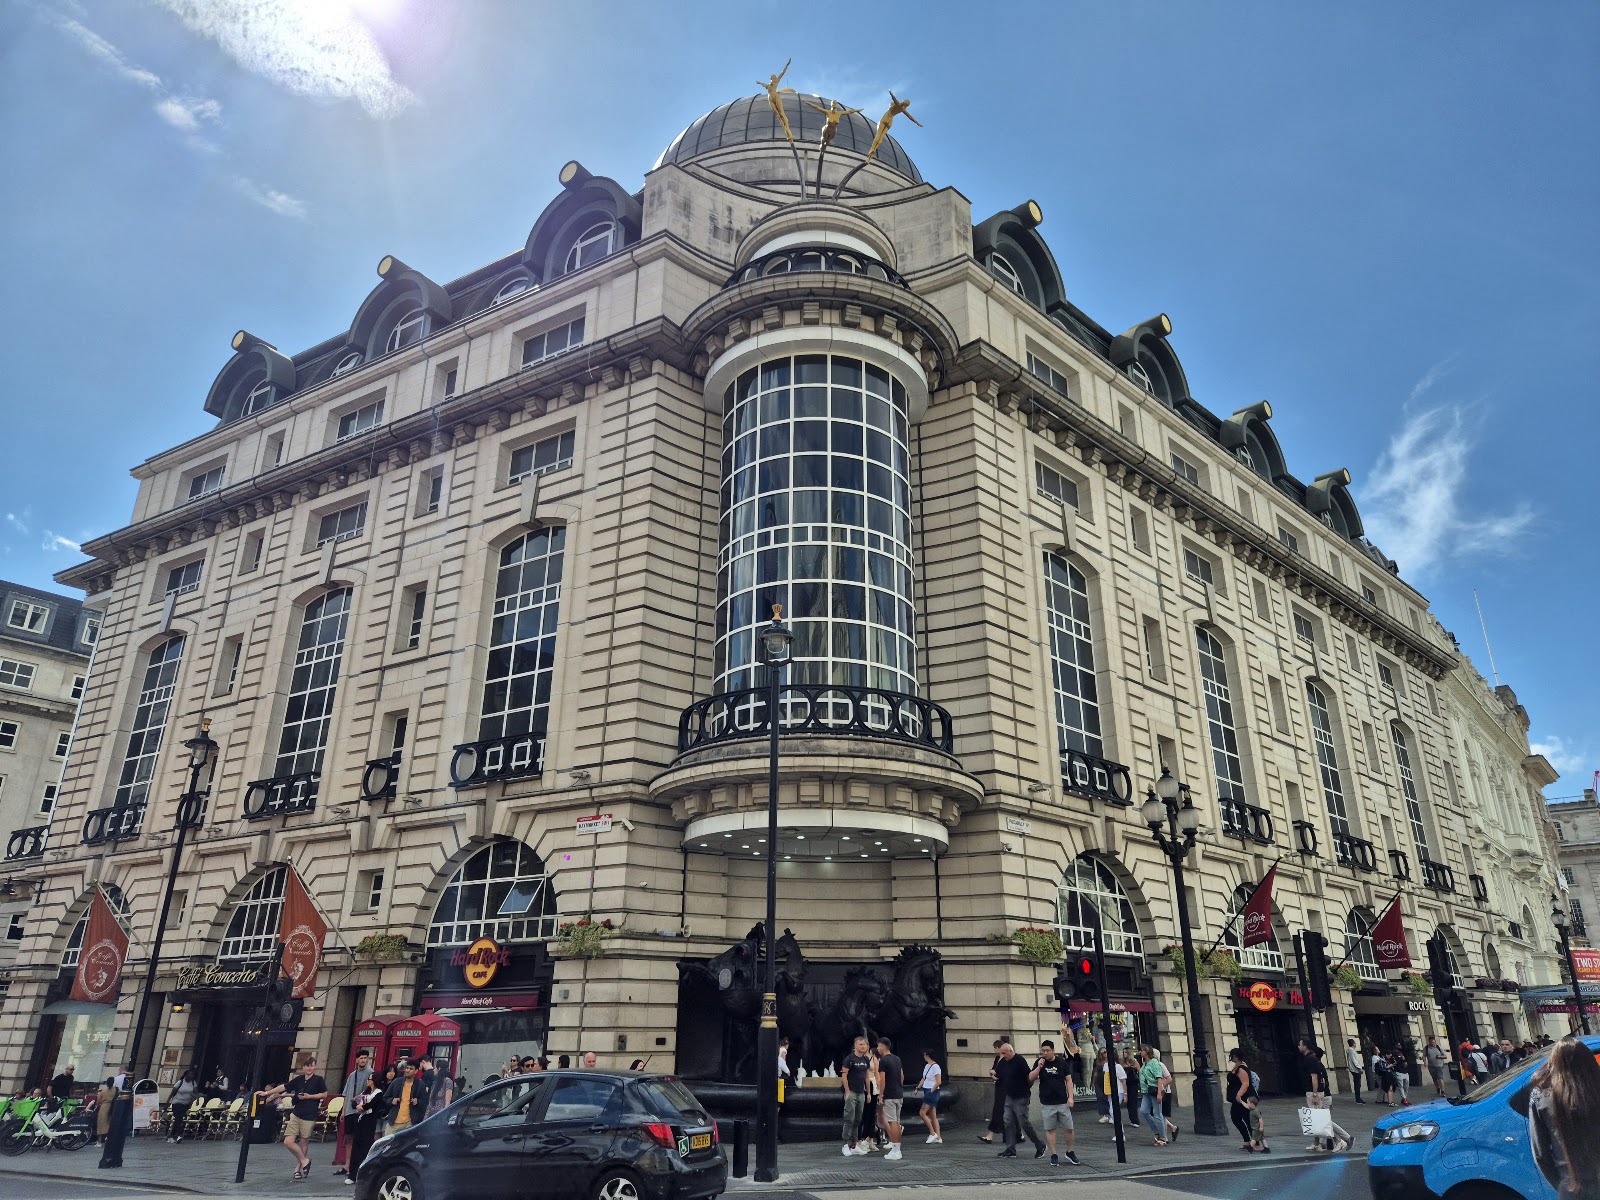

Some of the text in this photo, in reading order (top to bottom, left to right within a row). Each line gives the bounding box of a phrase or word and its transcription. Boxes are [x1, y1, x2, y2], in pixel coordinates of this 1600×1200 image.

[450, 946, 511, 968] Hard Rock
[1575, 957, 1592, 967] TWO
[205, 964, 257, 983] Concerto
[1239, 987, 1284, 1000] Hard Rock
[1303, 1108, 1313, 1135] M&S
